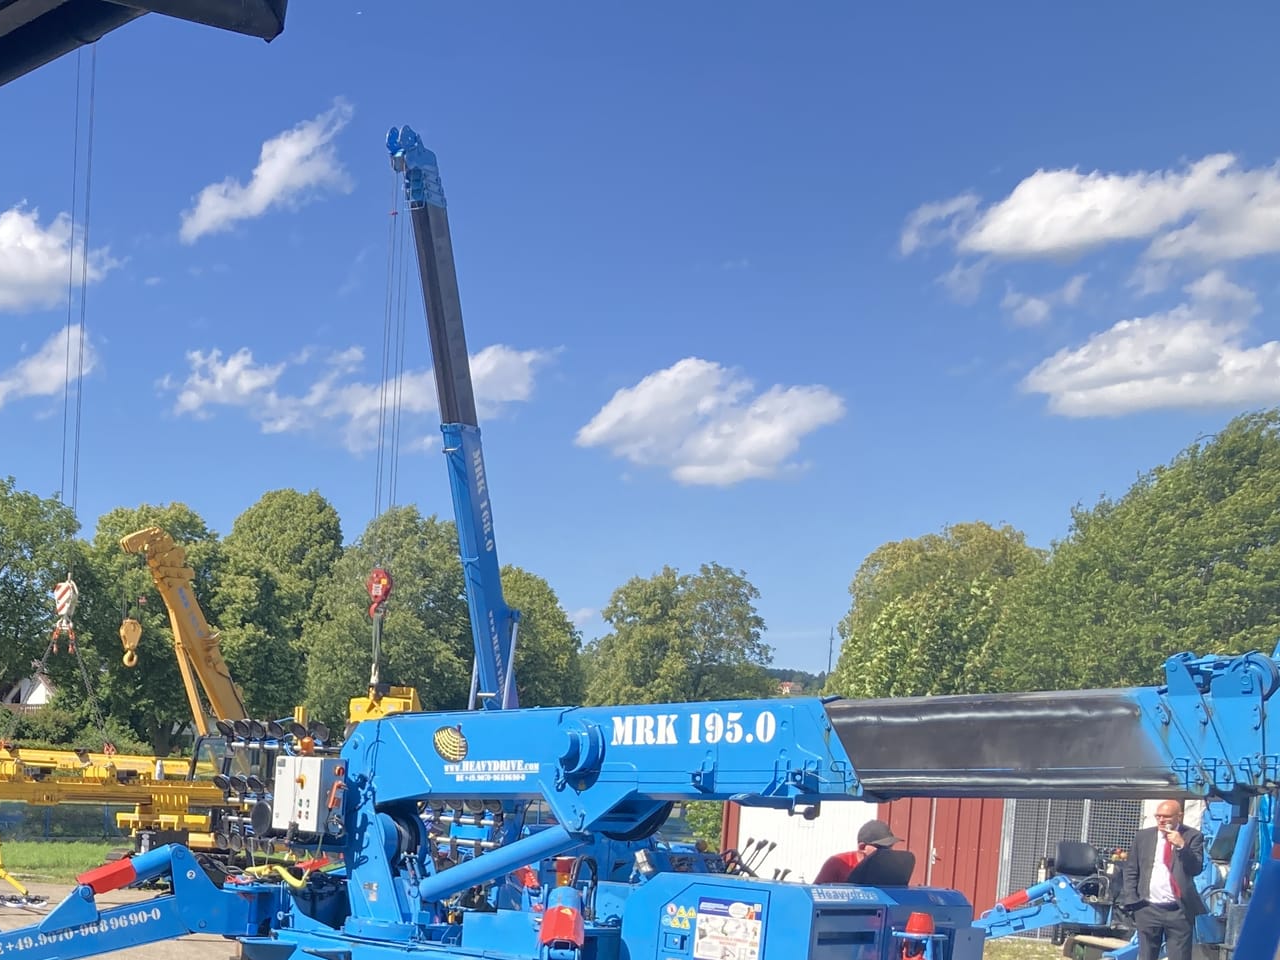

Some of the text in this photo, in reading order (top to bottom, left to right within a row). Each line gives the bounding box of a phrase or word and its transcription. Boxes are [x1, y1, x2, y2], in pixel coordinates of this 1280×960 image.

[473, 448, 486, 495] MRK
[610, 711, 776, 746] MRK 195.0
